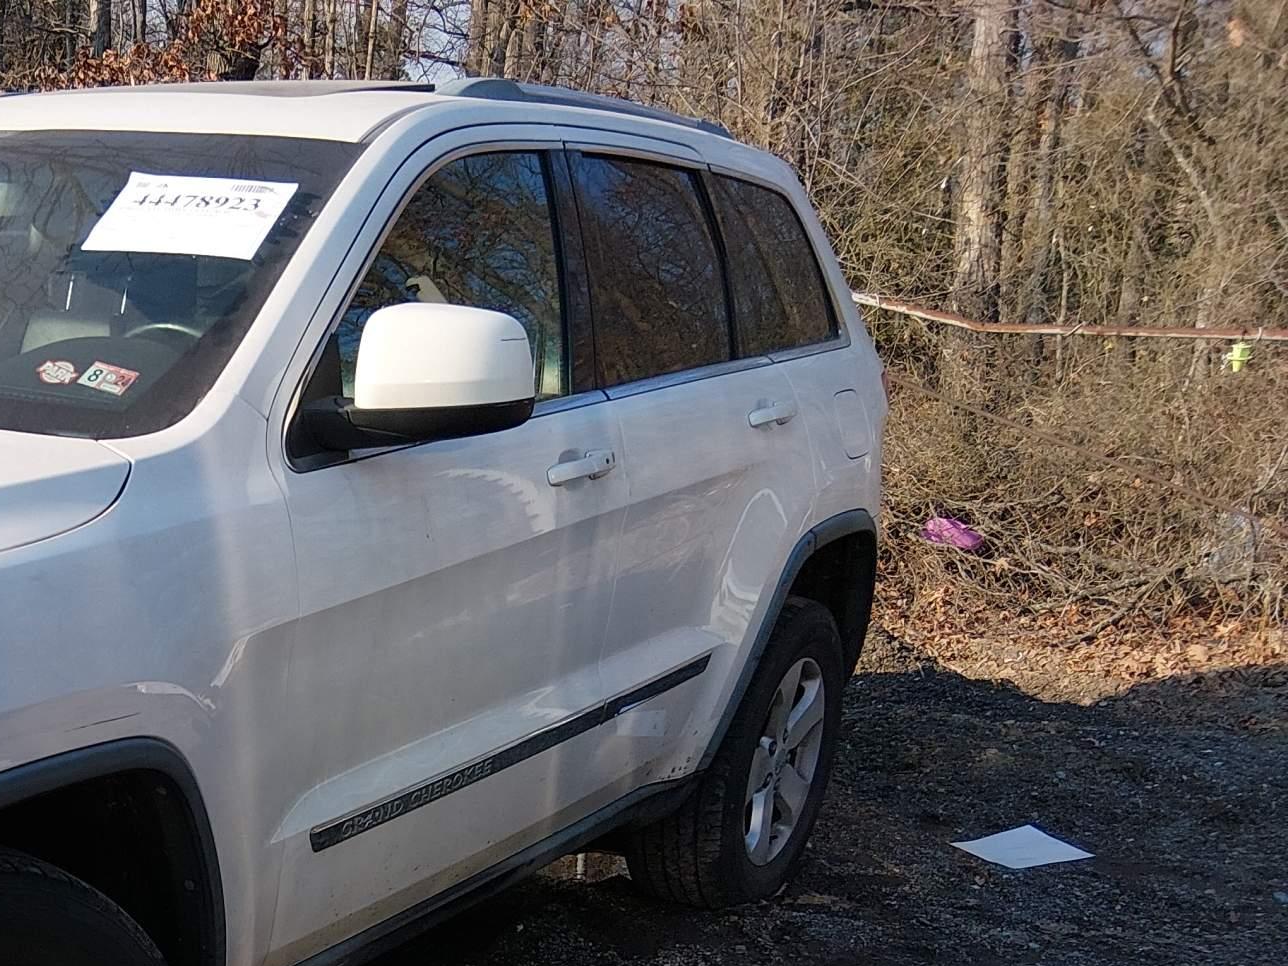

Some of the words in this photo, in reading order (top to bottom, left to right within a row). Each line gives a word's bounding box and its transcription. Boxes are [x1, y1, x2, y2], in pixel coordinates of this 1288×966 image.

[133, 194, 261, 212] 44478923
[88, 369, 103, 382] 8
[341, 799, 404, 838] GRAND
[410, 758, 494, 807] CHEROKEE
